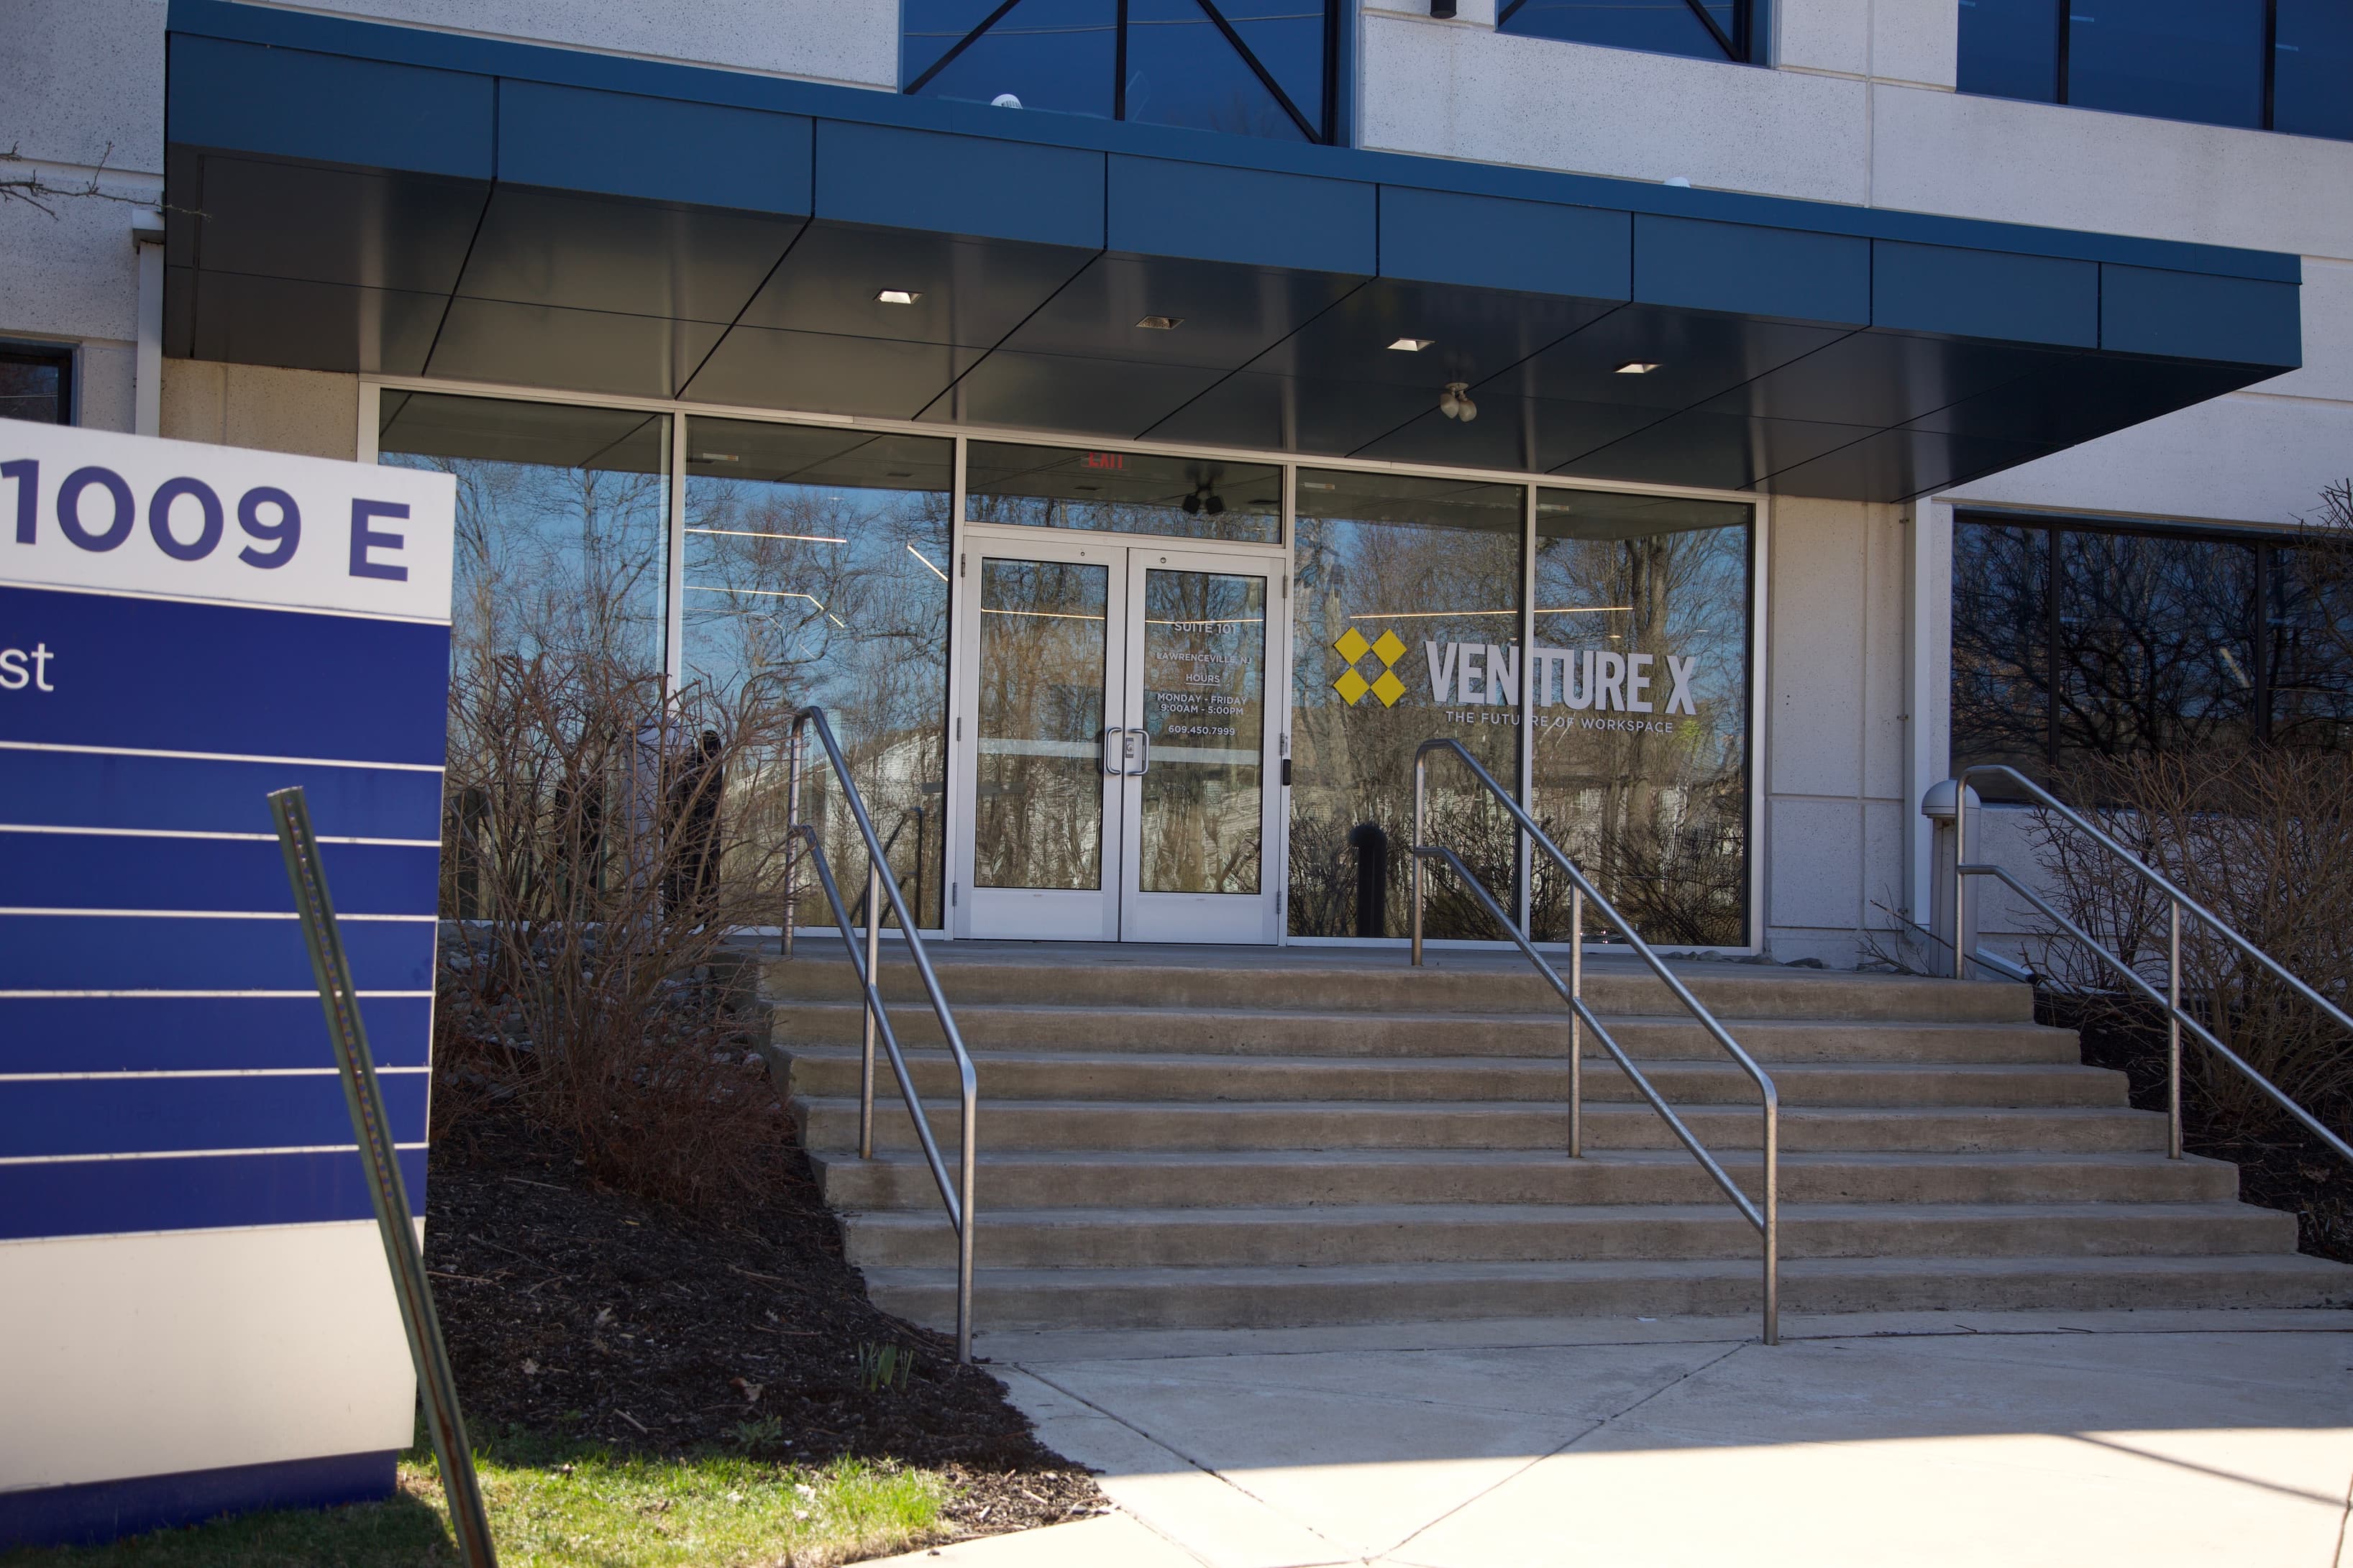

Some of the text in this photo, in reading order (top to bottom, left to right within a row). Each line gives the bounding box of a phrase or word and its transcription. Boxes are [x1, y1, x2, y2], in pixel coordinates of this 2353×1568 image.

[0, 458, 411, 582] 1009 E
[1174, 621, 1237, 633] SUITE 101
[1186, 674, 1220, 683] HOURS
[1425, 641, 1697, 715] VENTURE X
[1156, 693, 1201, 702] MONDAY
[1211, 696, 1248, 705] FRIDAY
[1161, 704, 1198, 713] 9:00AM
[1207, 706, 1243, 715] 5:00PM
[1445, 711, 1673, 733] THE FUTURE OF WORKSPACE
[1168, 725, 1235, 736] 609.450.7999
